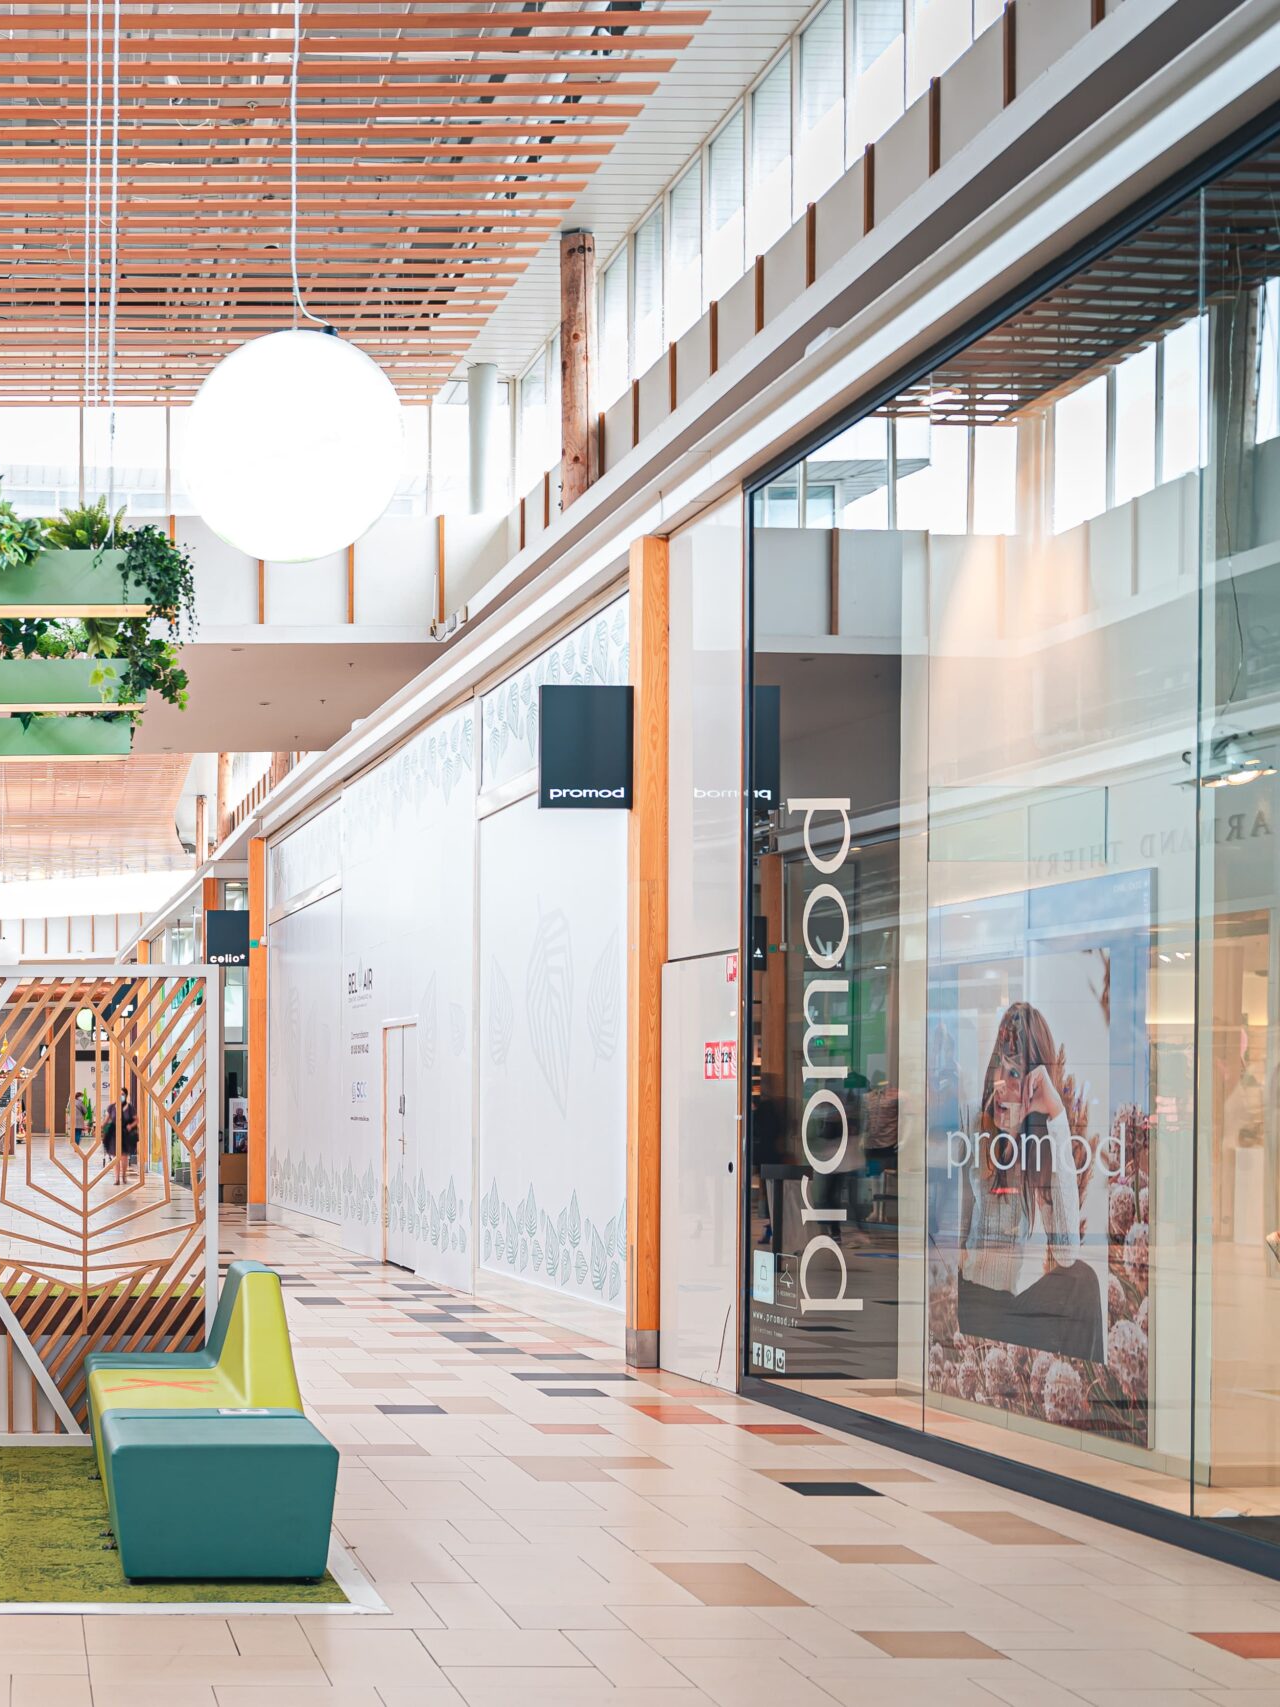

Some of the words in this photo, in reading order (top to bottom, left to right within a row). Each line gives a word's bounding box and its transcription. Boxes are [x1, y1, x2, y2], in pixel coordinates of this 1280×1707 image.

[549, 787, 625, 800] promod
[787, 798, 863, 1315] promod
[946, 1122, 1126, 1180] promod
[752, 1310, 799, 1328] www.promod.fr
